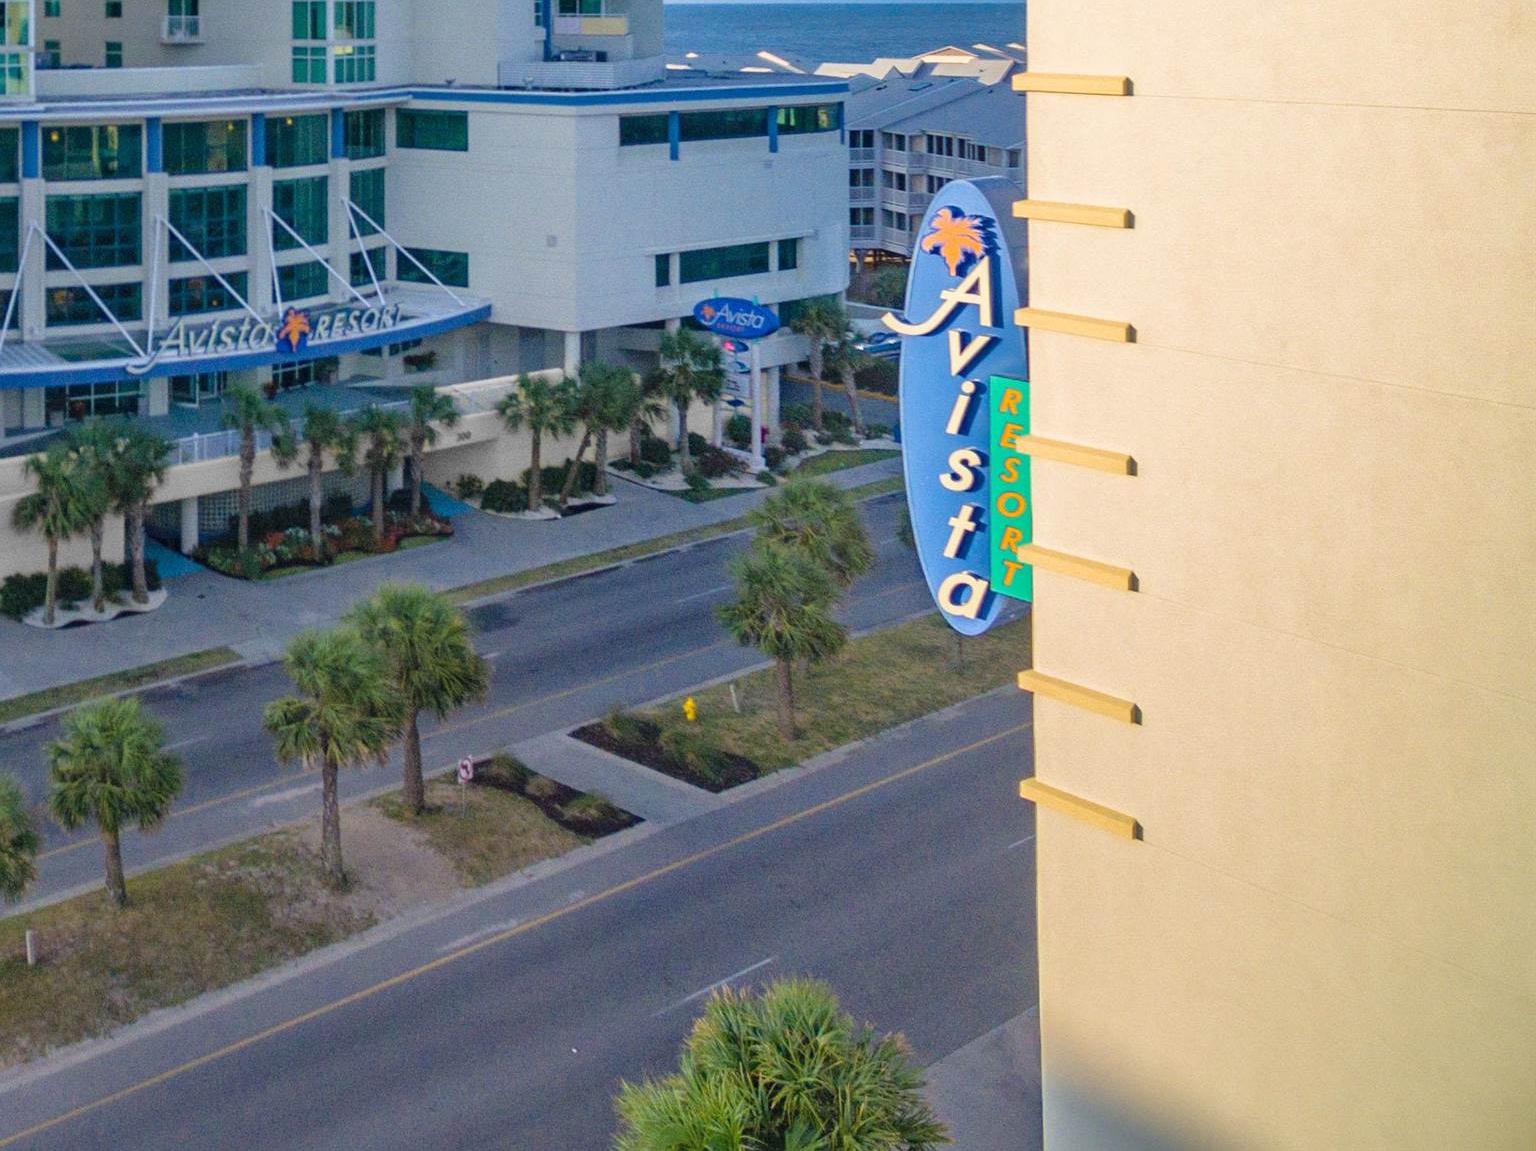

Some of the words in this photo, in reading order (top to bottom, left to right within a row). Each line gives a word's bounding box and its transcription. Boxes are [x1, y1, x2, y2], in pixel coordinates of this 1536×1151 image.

[126, 315, 275, 375] Avista
[313, 303, 405, 341] RESORT
[700, 303, 764, 329] Avista
[882, 255, 994, 621] Avista
[996, 387, 1027, 587] RESORT
